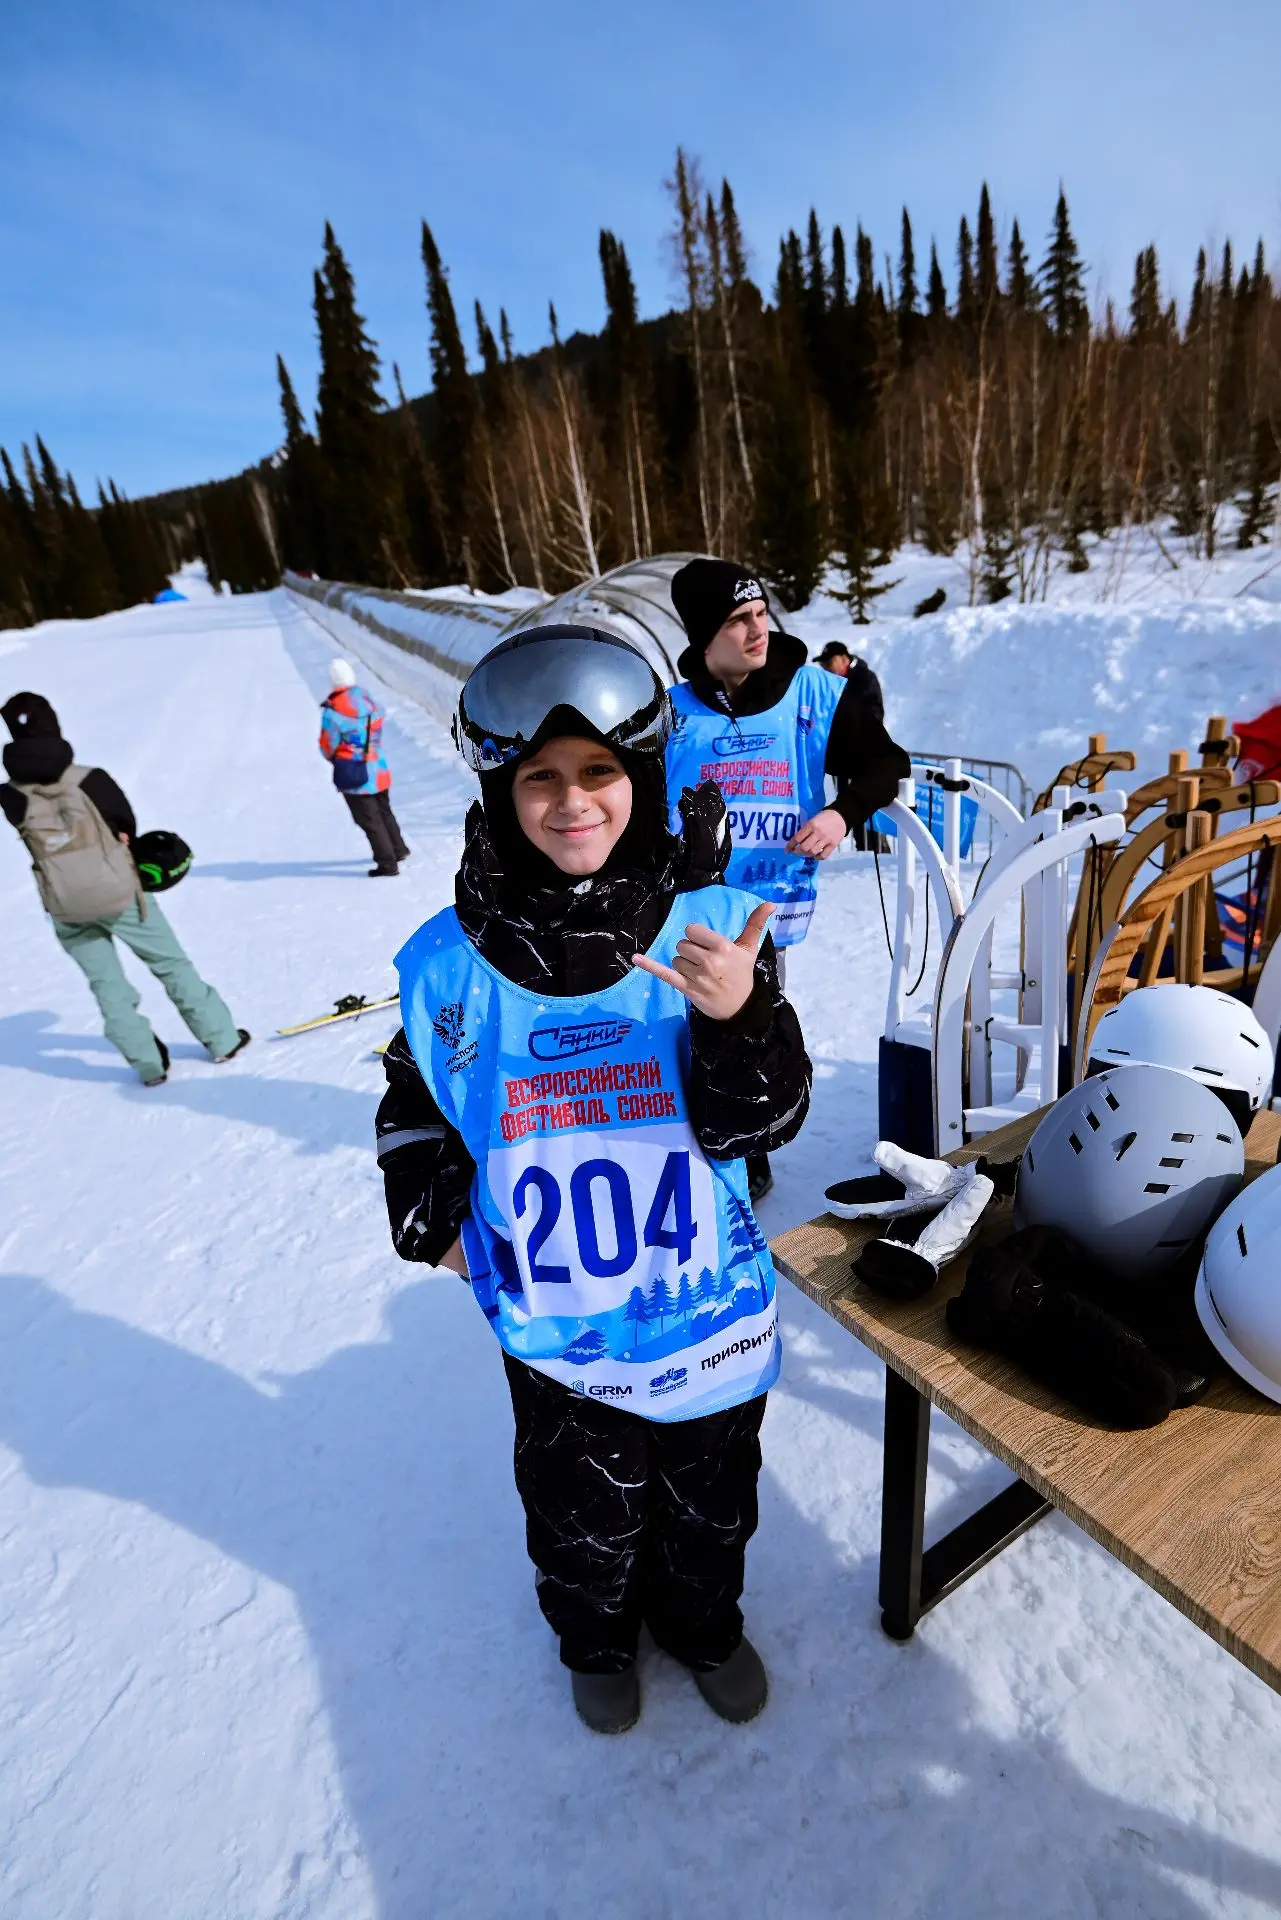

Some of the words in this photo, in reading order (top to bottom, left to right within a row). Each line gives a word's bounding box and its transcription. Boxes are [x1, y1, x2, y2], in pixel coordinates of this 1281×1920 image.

[701, 757, 789, 780] ВСЕРОССИЙСКИЙ
[696, 780, 757, 796] ТИВАЛЬ
[762, 780, 795, 797] САНОК
[728, 811, 801, 841] РУКТО
[449, 1052, 479, 1075] РОССИИ
[505, 1055, 662, 1108] ВСЕРОССИЙСКИЙ
[500, 1097, 611, 1143] ФЕСТИВАЛЬ
[617, 1091, 677, 1121] САНОК
[512, 1150, 698, 1284] 204
[701, 1310, 778, 1371] приоритет
[588, 1385, 633, 1396] GRM
